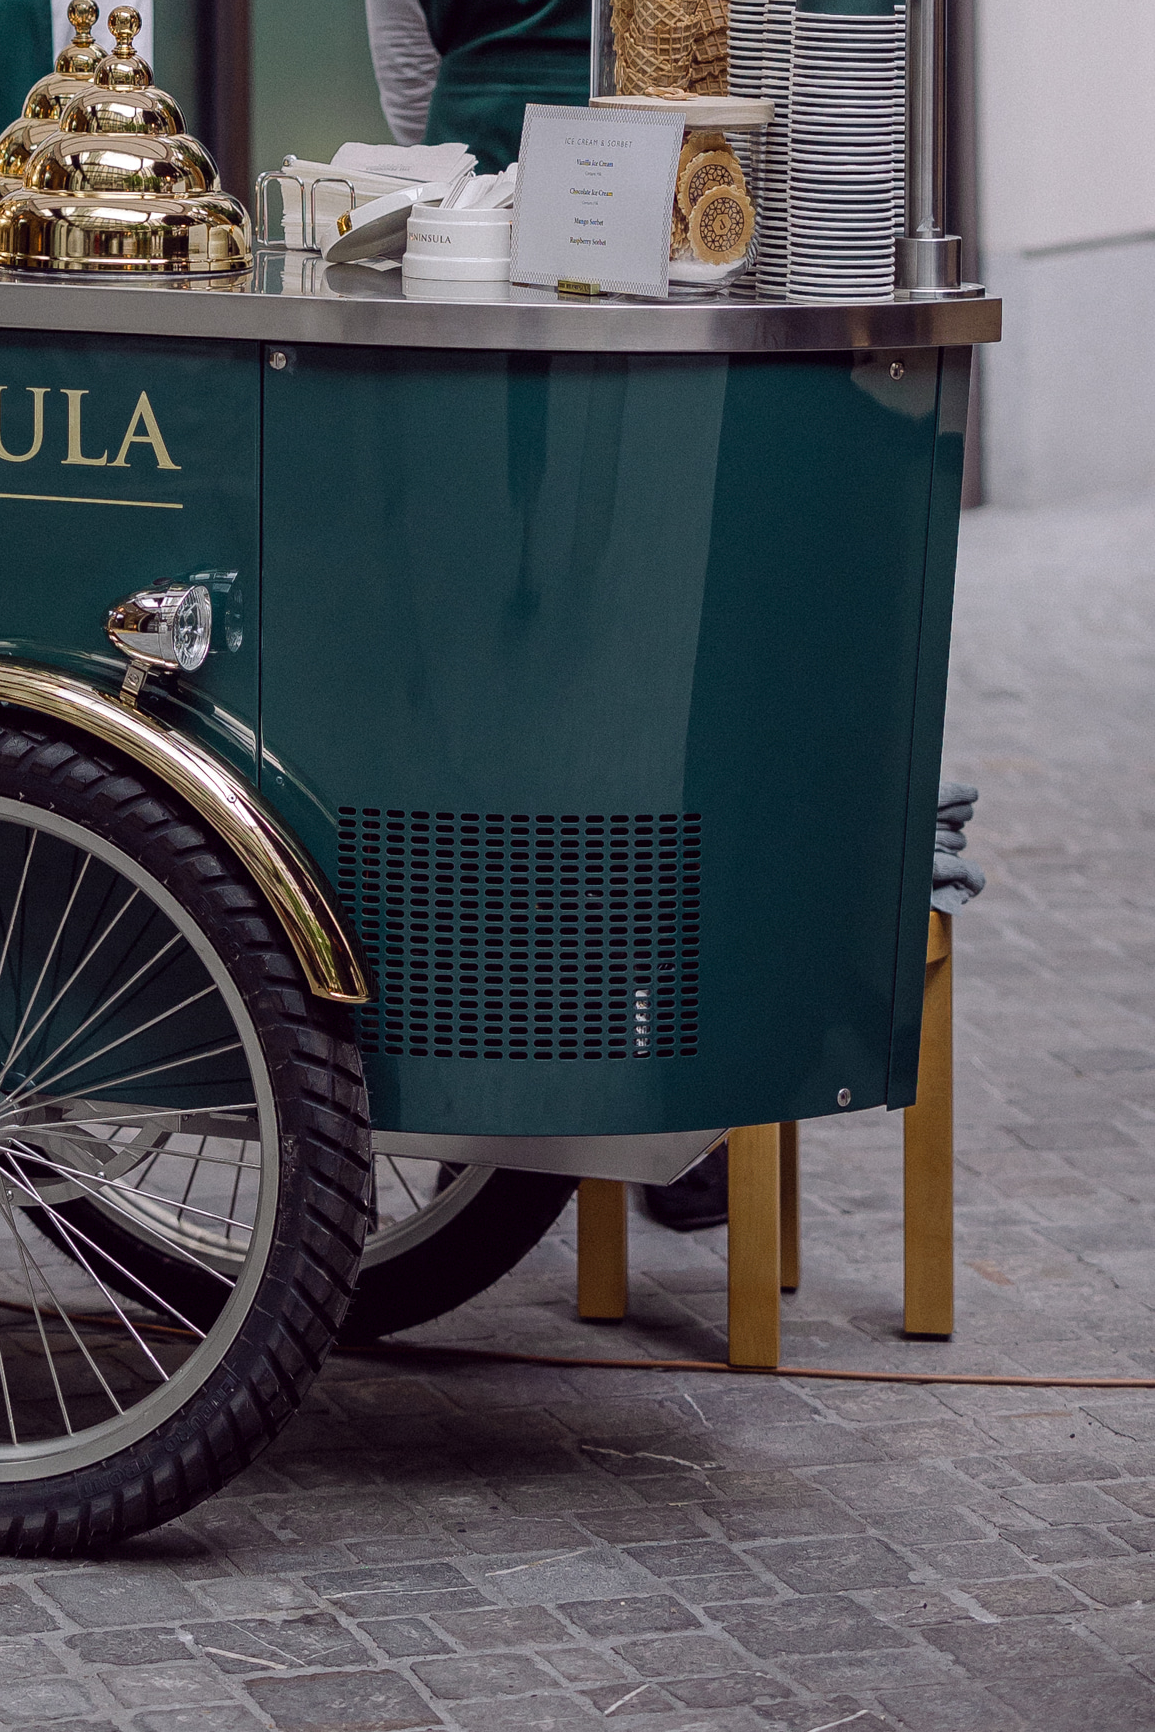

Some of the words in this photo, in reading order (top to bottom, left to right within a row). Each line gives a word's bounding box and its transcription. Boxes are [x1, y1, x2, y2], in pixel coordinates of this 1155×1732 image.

[564, 137, 575, 145] ICE
[577, 138, 598, 146] CREAM
[607, 139, 633, 148] SORBET
[569, 236, 592, 246] Raspberry
